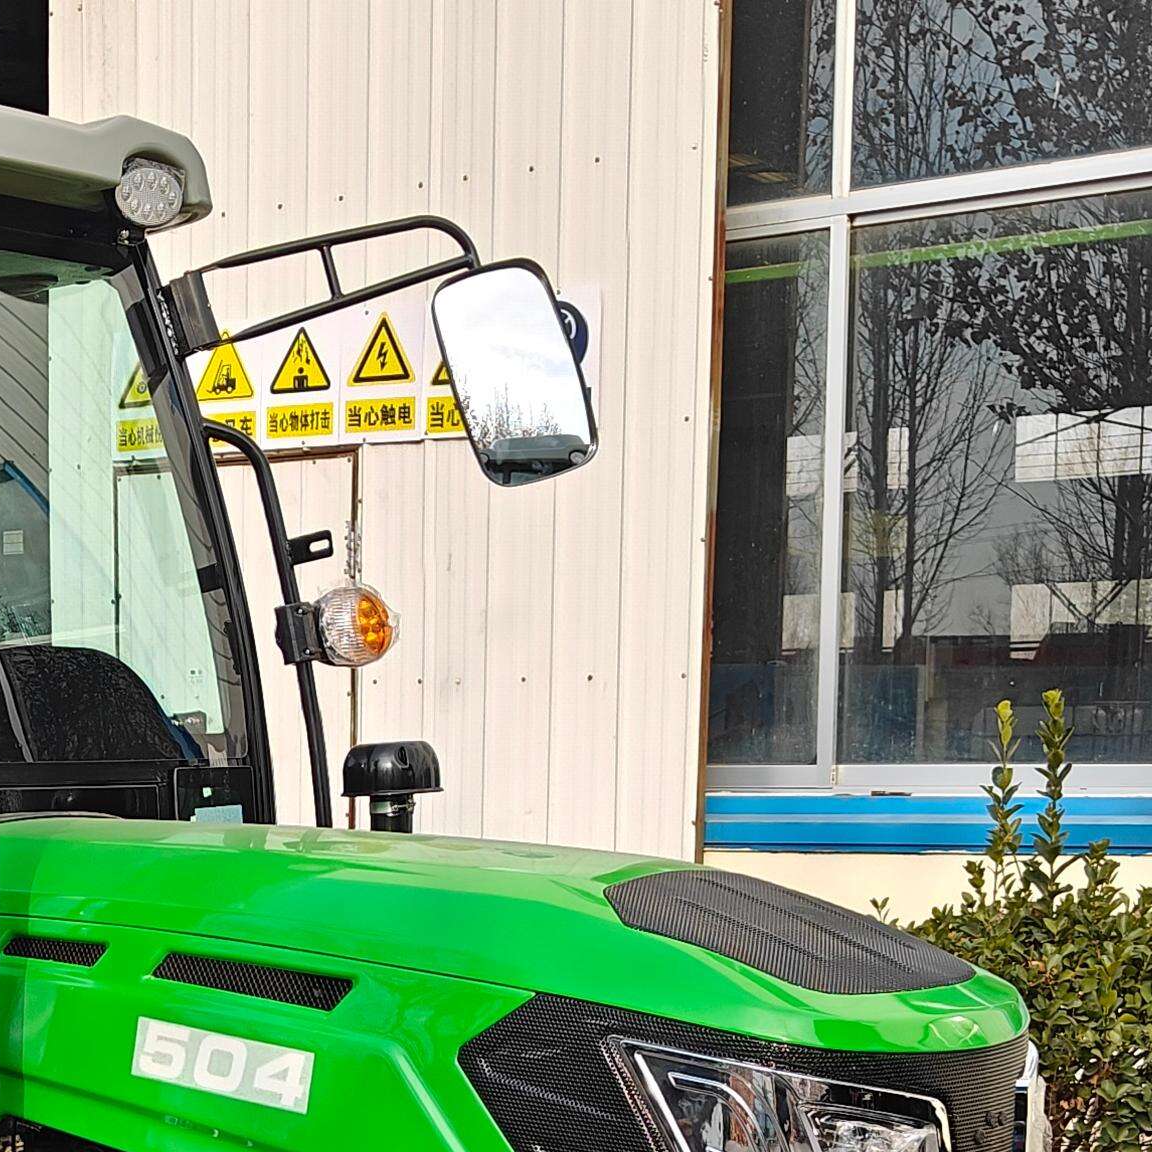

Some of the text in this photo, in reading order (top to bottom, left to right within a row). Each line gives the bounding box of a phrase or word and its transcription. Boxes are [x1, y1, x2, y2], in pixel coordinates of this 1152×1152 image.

[269, 409, 331, 433] 当心物体打击
[347, 403, 413, 428] 当心触电
[138, 1021, 306, 1107] 504
